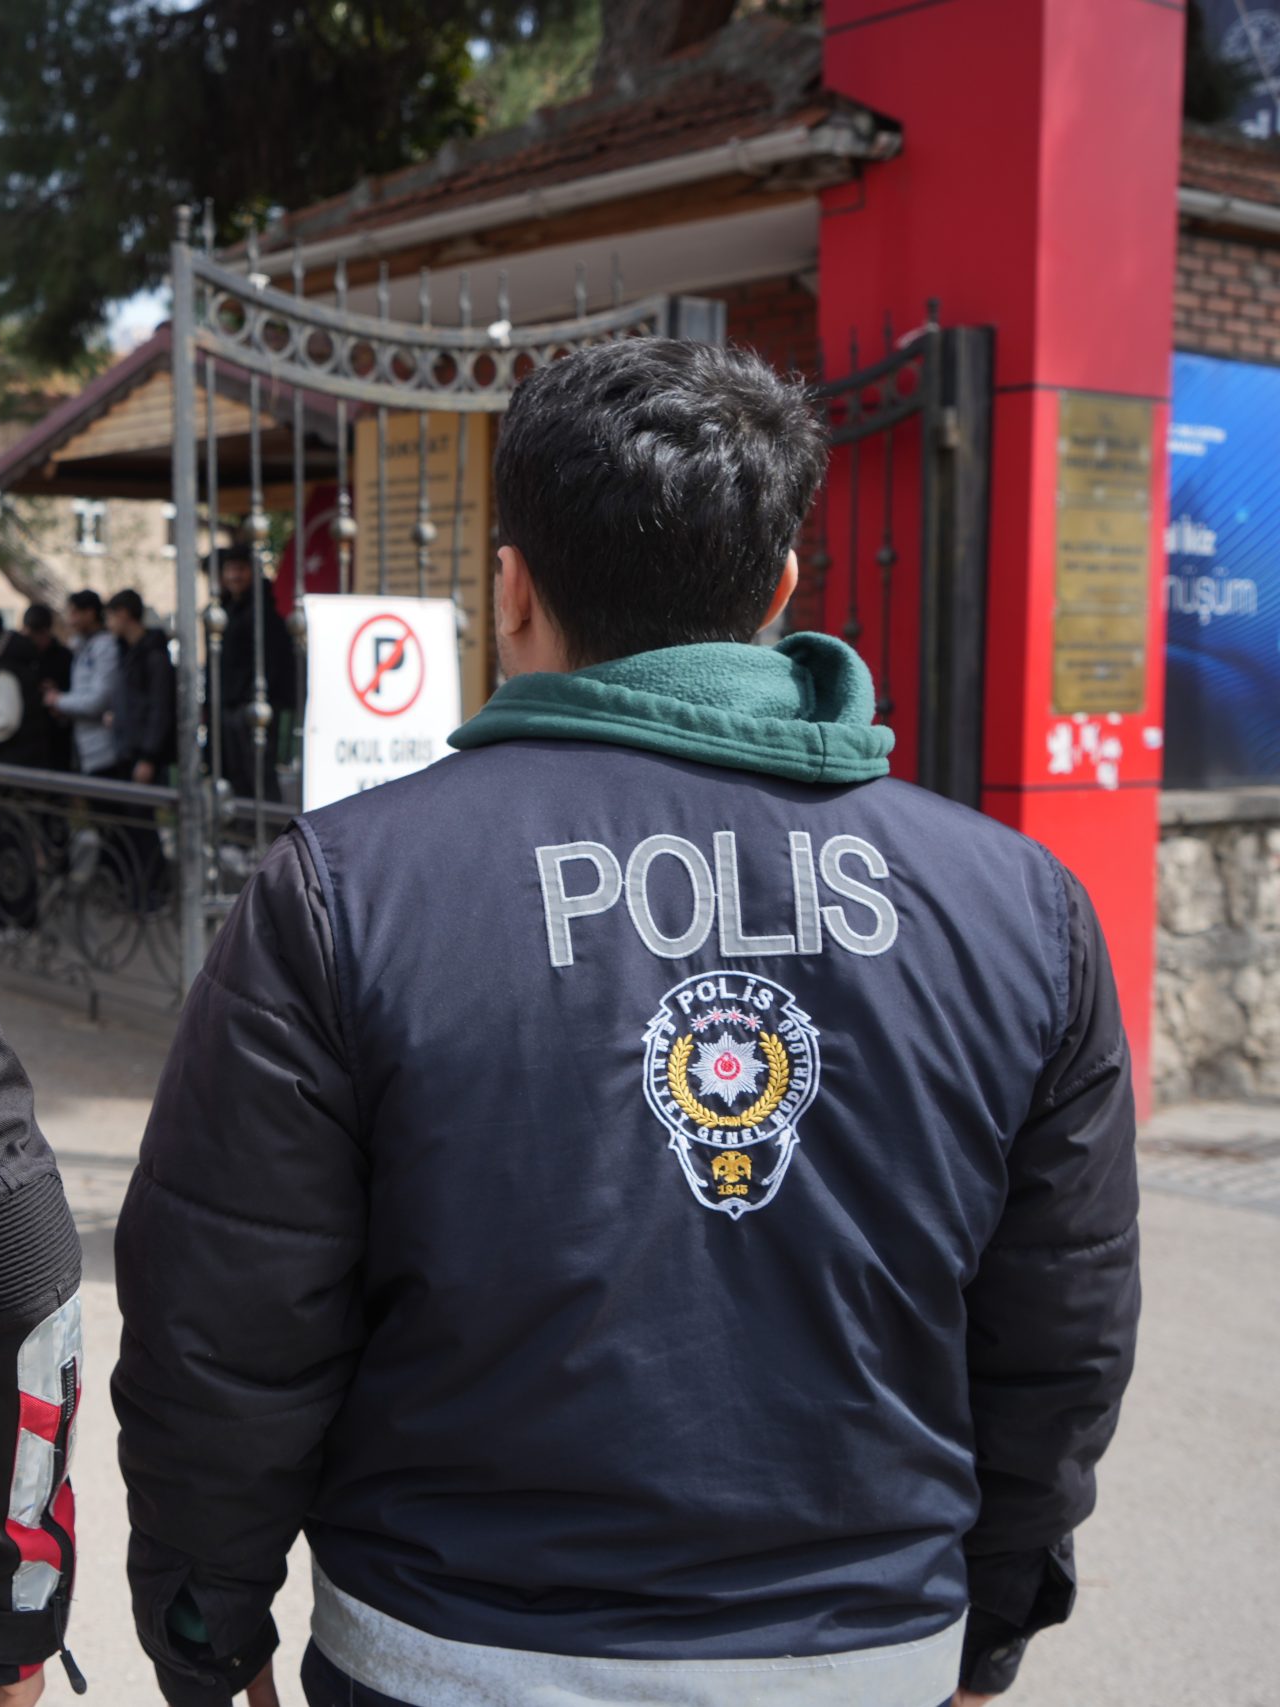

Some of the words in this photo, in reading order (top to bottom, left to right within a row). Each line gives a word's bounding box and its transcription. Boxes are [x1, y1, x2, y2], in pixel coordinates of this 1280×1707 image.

[336, 737, 383, 764] OKUL
[697, 1125, 766, 1144] GENEL
[717, 1184, 749, 1195] 1845
